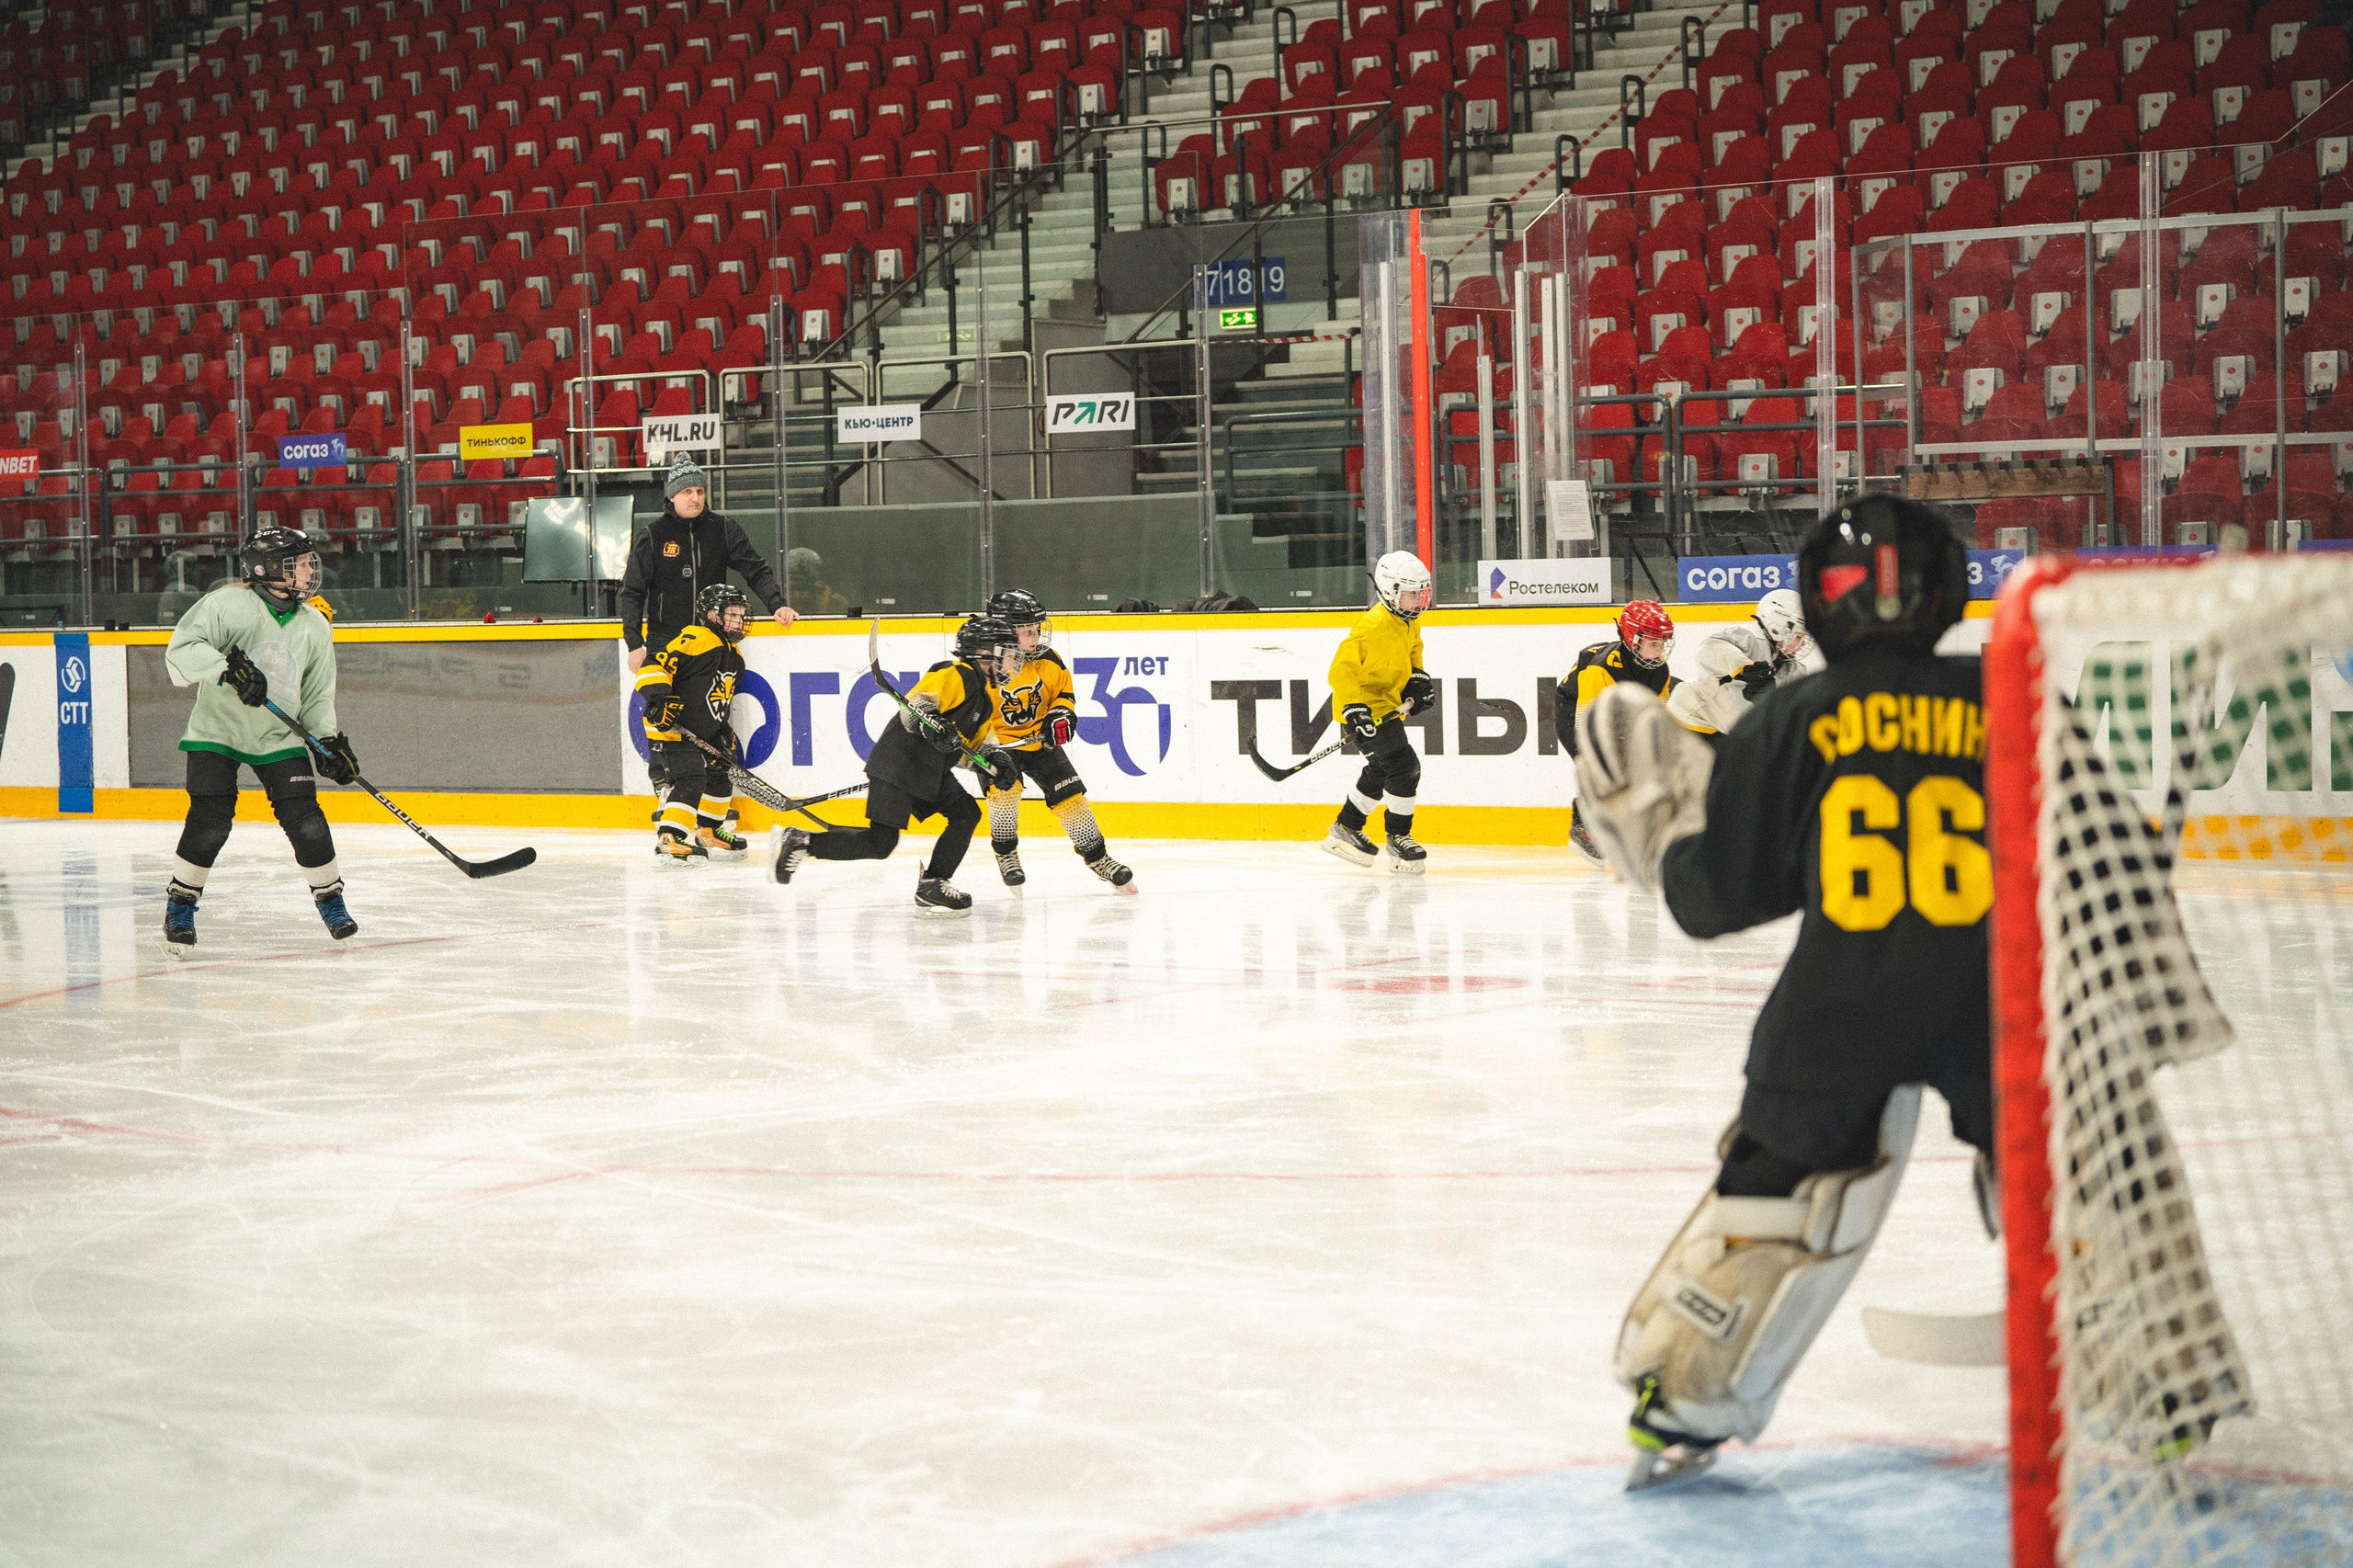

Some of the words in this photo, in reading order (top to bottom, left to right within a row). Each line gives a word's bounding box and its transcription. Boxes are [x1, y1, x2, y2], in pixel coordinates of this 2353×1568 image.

[1223, 267, 1252, 295] 18
[1051, 399, 1130, 426] PARI
[466, 435, 527, 448] ТИНЬКОФФ
[646, 421, 716, 444] KHL.RU
[1508, 581, 1599, 595] Ростелеком
[1124, 656, 1169, 676] лет
[1819, 774, 1995, 933] 66
